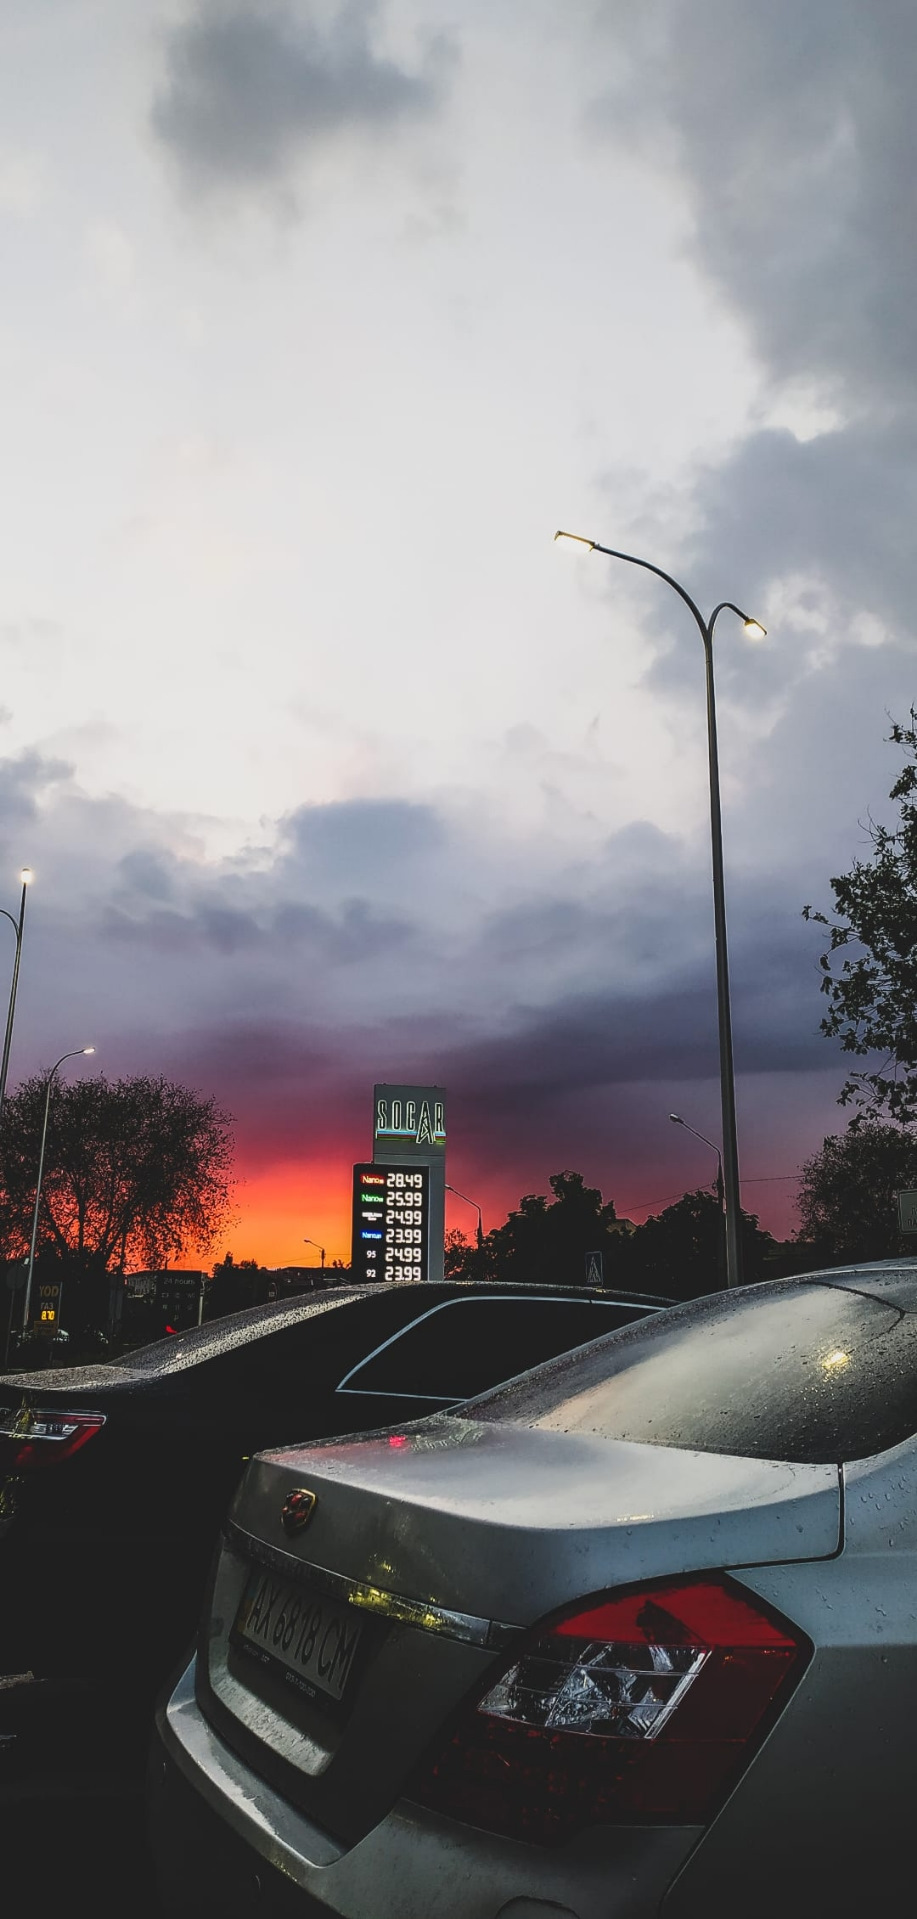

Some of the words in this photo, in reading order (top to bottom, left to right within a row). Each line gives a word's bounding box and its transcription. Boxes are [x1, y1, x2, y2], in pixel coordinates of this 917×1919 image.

[377, 1099, 444, 1144] SOCAR
[386, 1173, 423, 1188] 28.49
[386, 1191, 422, 1207] 25.99
[385, 1209, 422, 1225] 24.99
[385, 1228, 422, 1244] 23.99
[366, 1250, 377, 1259] 95
[385, 1247, 422, 1263] 24.99
[366, 1269, 376, 1278] 92
[384, 1266, 422, 1281] 23.99
[39, 1285, 59, 1297] YOD
[40, 1302, 54, 1310] ГАЗ
[247, 1578, 282, 1640] AX
[272, 1592, 322, 1666] 6818
[317, 1616, 361, 1690] CM
